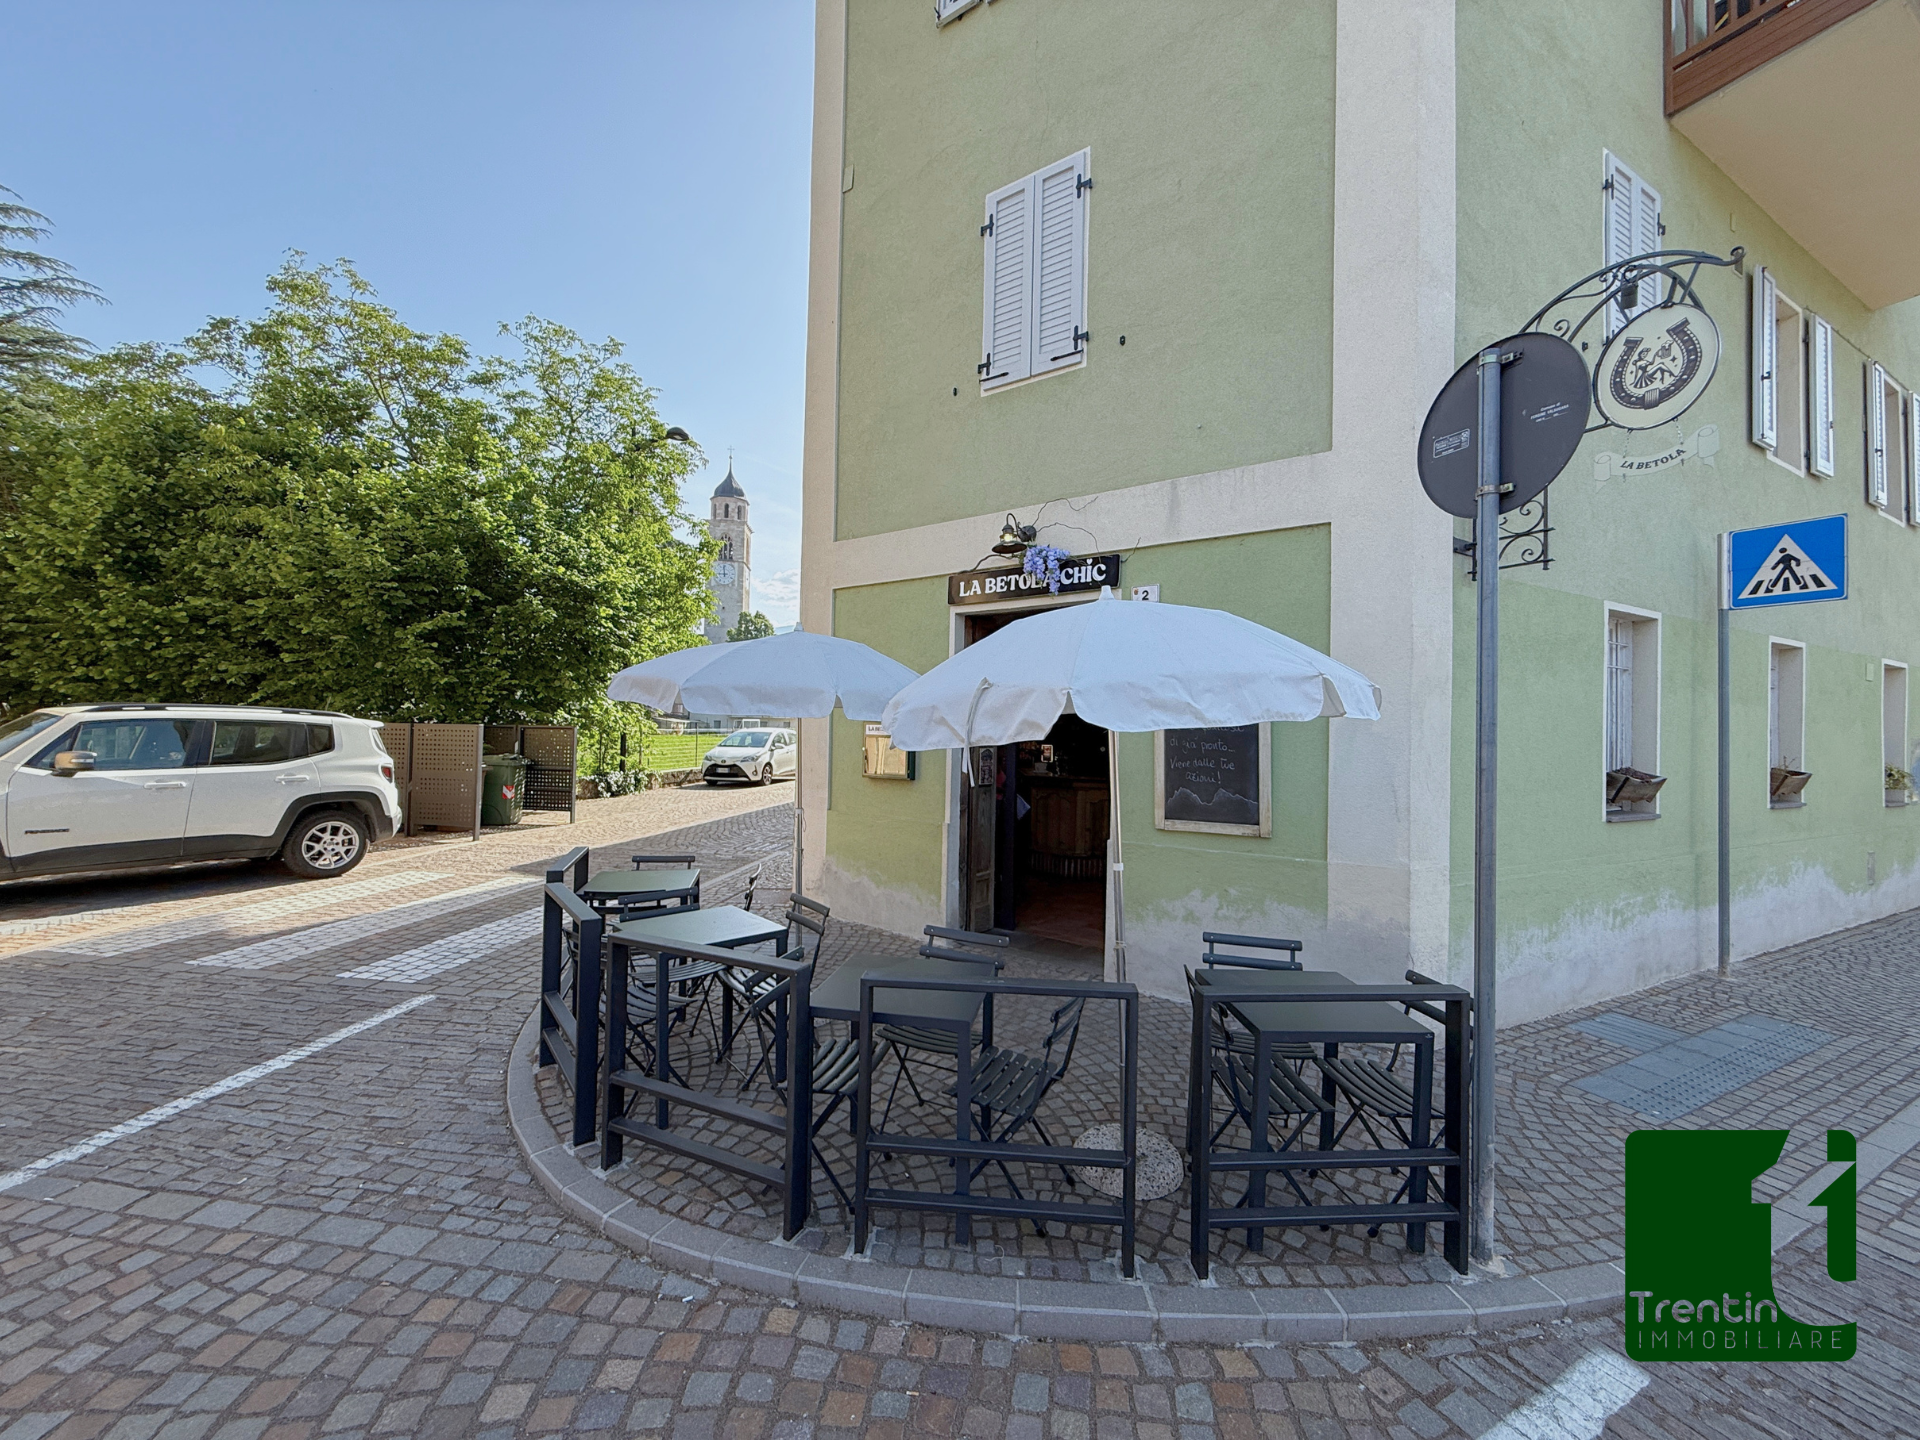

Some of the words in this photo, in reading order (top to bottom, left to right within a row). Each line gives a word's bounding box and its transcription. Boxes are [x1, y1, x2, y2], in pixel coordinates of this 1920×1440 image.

[1620, 460, 1634, 469] LA
[1635, 448, 1687, 470] BETOLA
[959, 579, 982, 597] LA
[1141, 589, 1150, 601] 2
[1170, 756, 1191, 769] Viene
[1193, 757, 1215, 769] dalle
